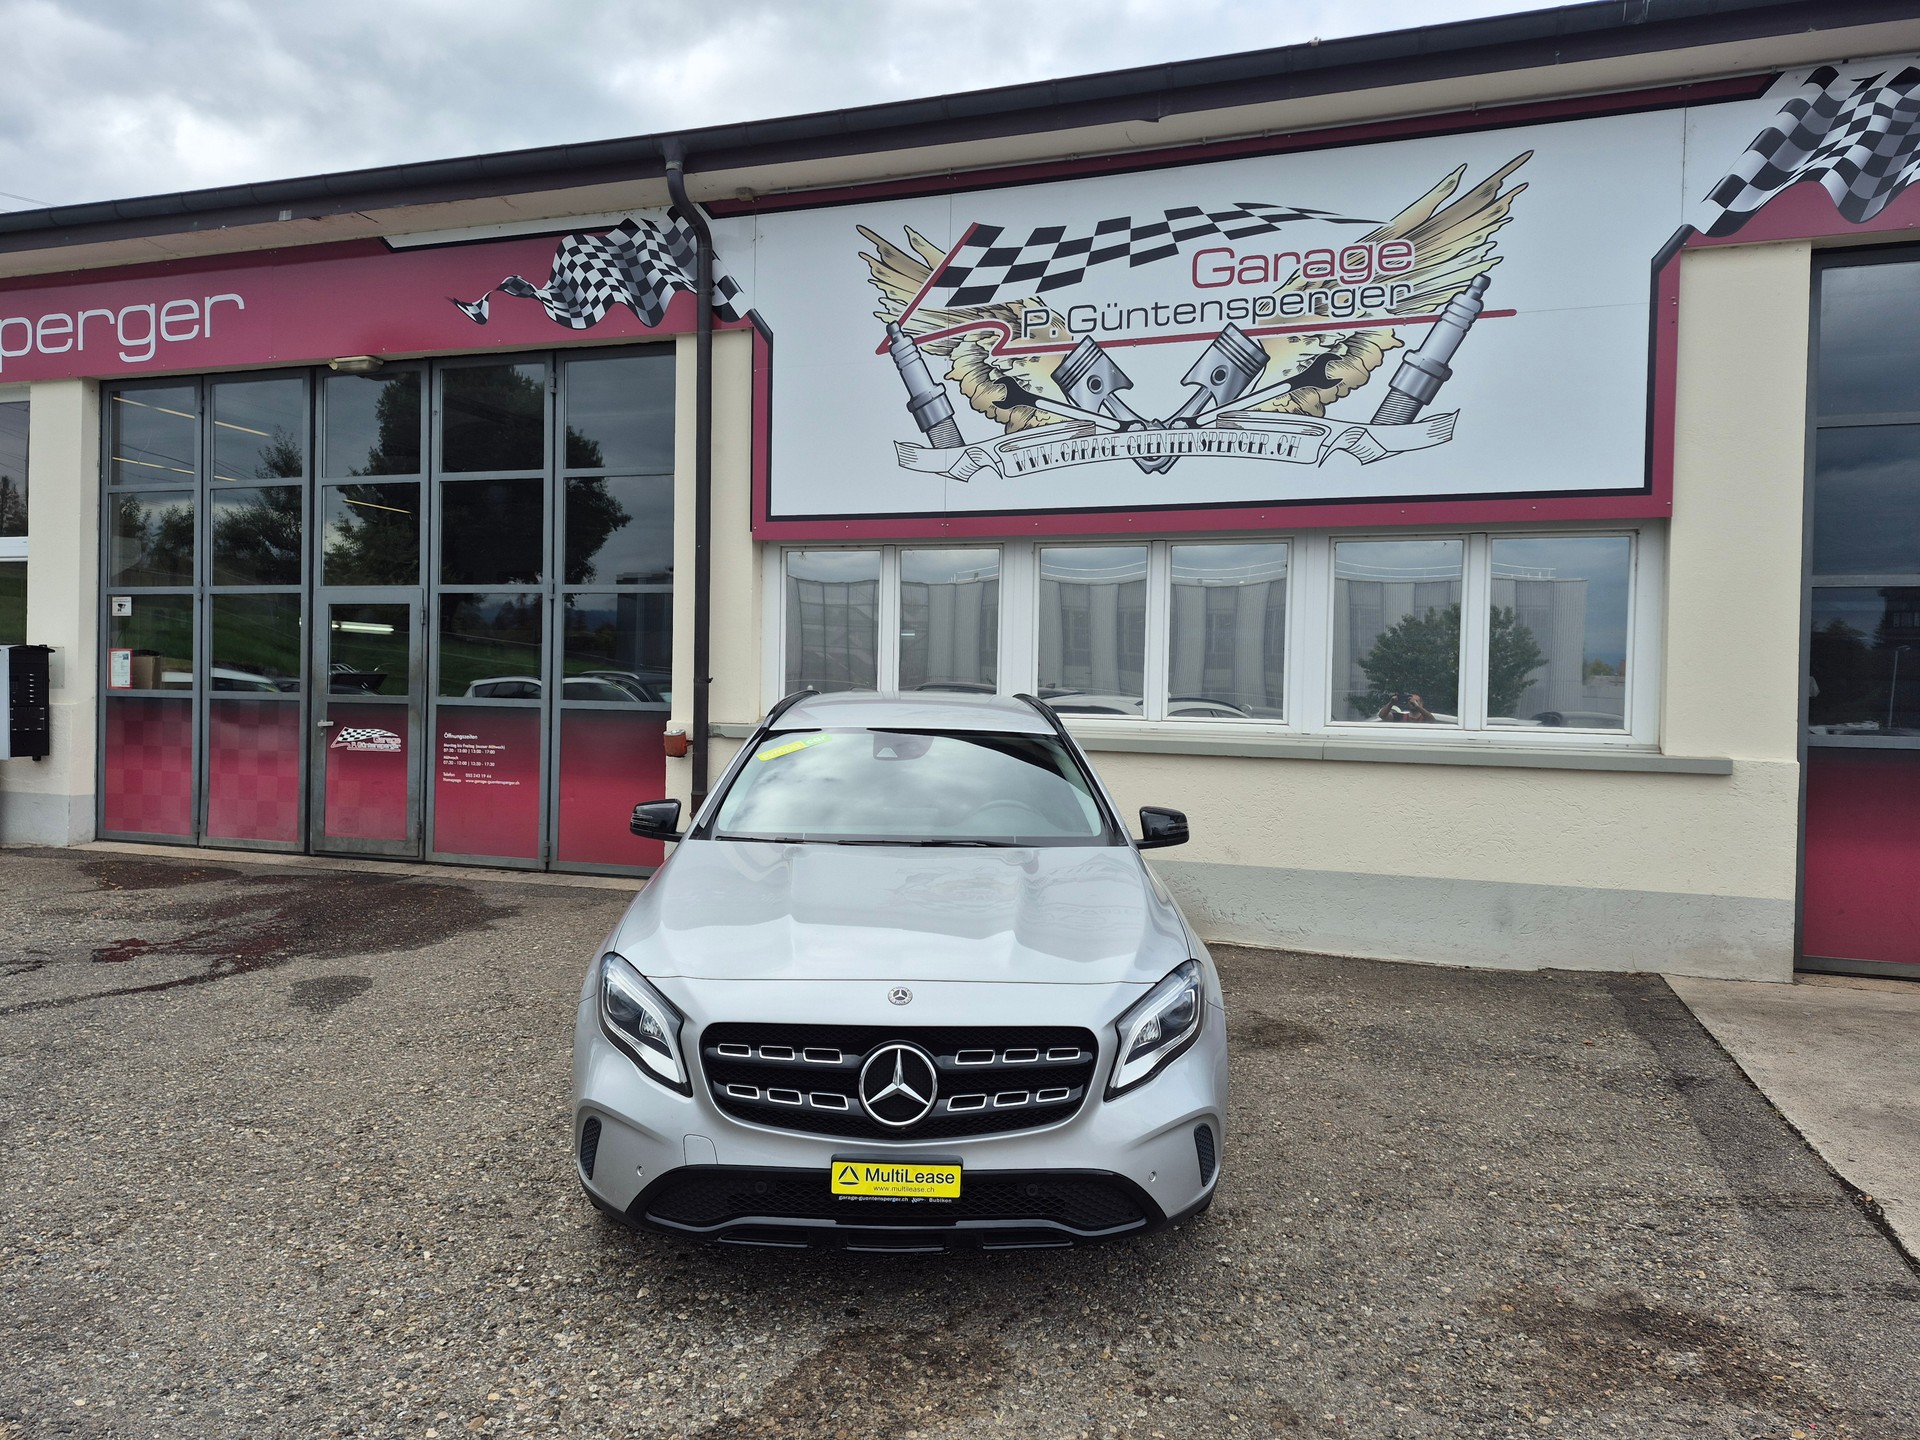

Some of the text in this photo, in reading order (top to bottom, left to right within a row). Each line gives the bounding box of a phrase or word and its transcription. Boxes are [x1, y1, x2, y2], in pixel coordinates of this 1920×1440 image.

[1191, 240, 1414, 289] Garage
[1022, 282, 1412, 338] P. Güntensperger
[865, 1167, 955, 1184] MultiLease
[873, 1185, 935, 1193] www.multilease.ch
